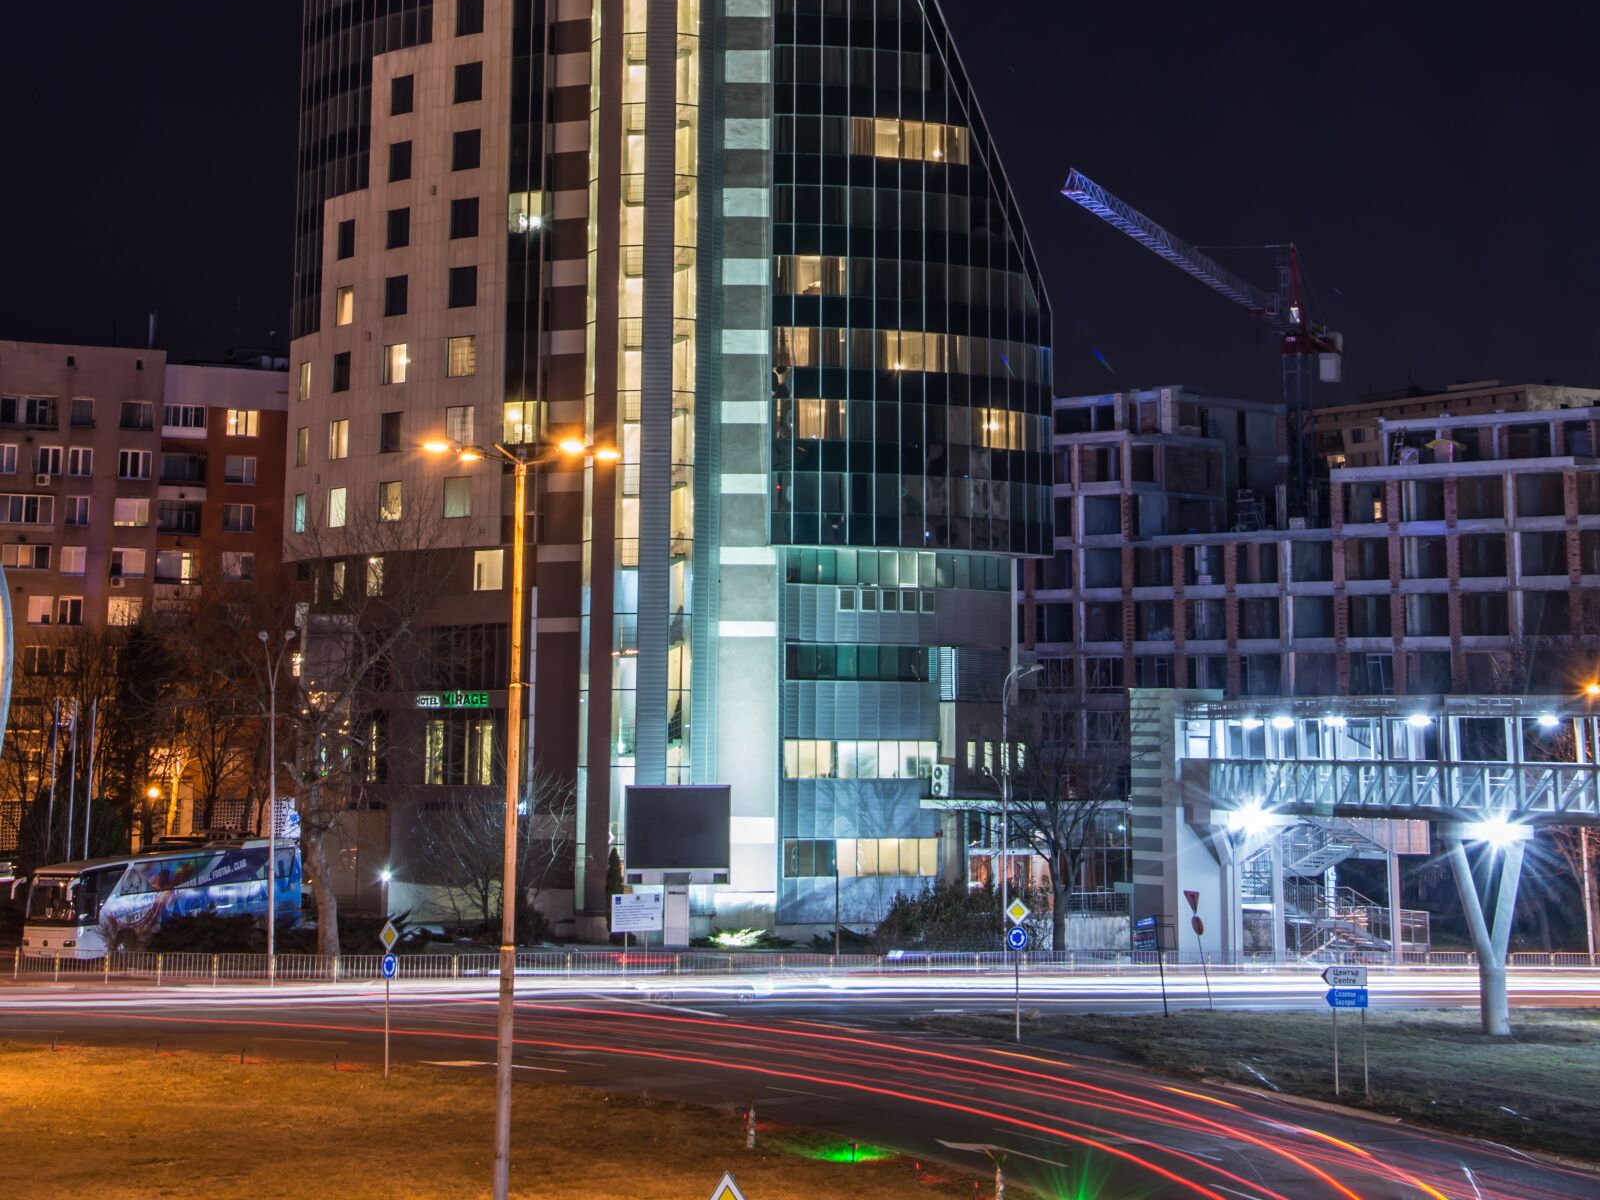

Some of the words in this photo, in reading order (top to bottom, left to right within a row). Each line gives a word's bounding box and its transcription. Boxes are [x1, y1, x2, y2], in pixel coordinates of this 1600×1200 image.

[416, 696, 439, 706] HOTEL
[442, 691, 488, 705] MIRAGE
[1333, 969, 1359, 977] Център
